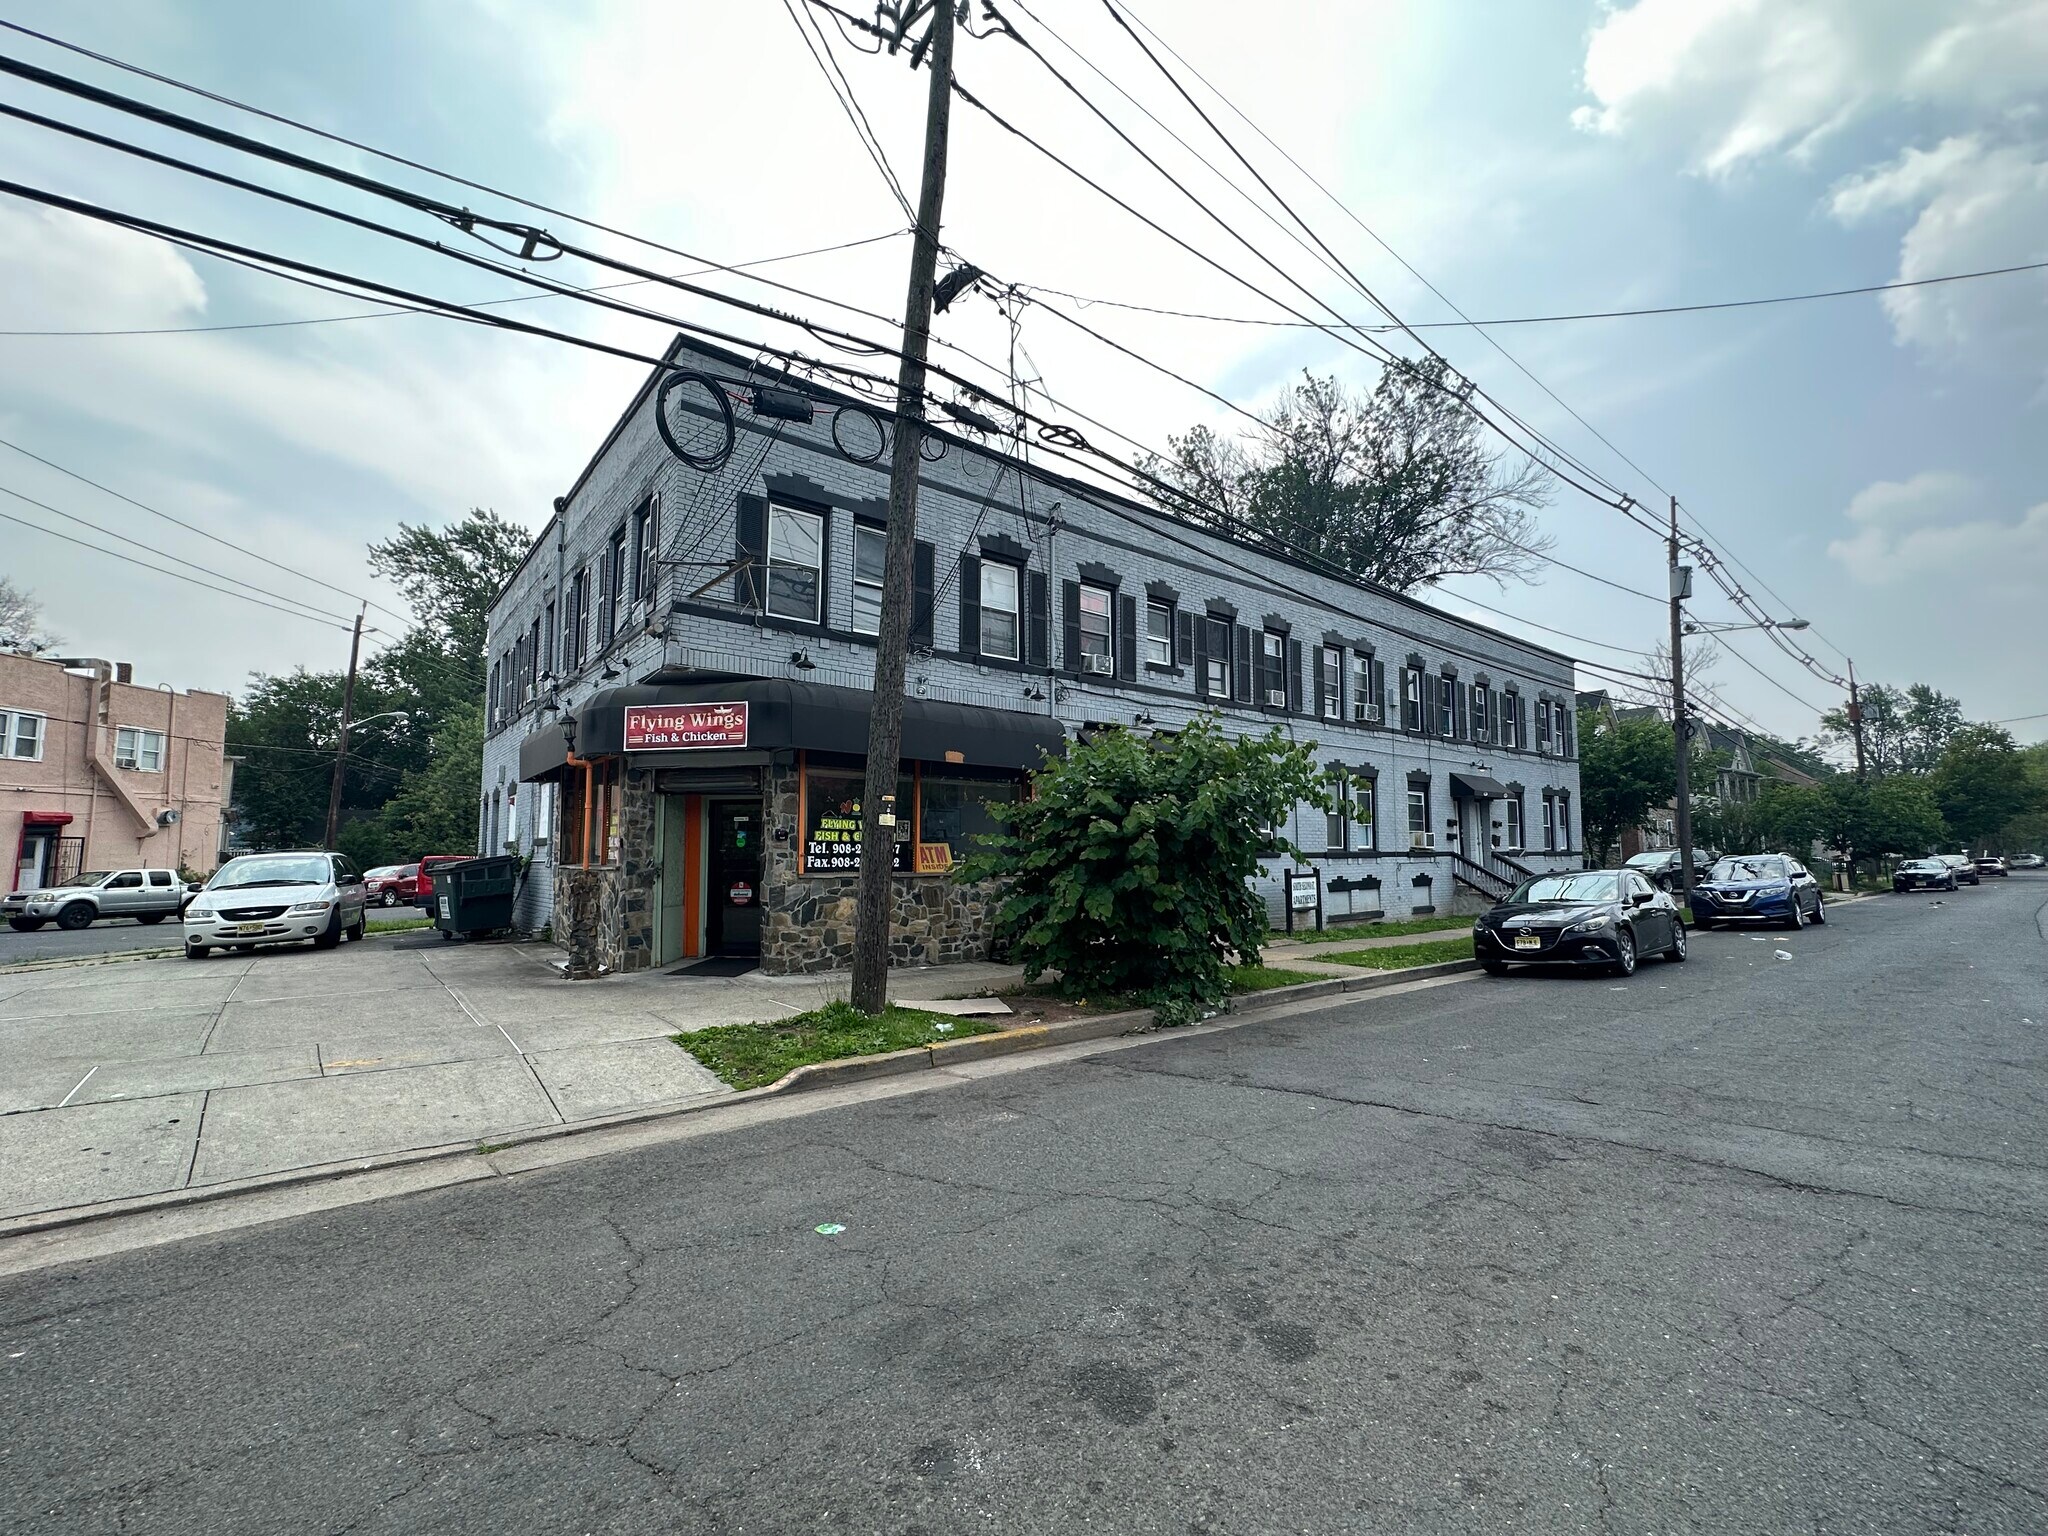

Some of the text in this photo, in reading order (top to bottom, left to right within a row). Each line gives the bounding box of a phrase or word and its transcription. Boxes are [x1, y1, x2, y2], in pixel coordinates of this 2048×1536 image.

[629, 712, 744, 732] Flying Wings
[644, 731, 727, 743] Fish & Chicken
[820, 818, 856, 830] FLYING
[814, 830, 840, 841] FISH
[841, 831, 850, 841] &
[809, 842, 829, 854] Tel.
[920, 846, 948, 864] ATM
[807, 855, 831, 868] Fax.
